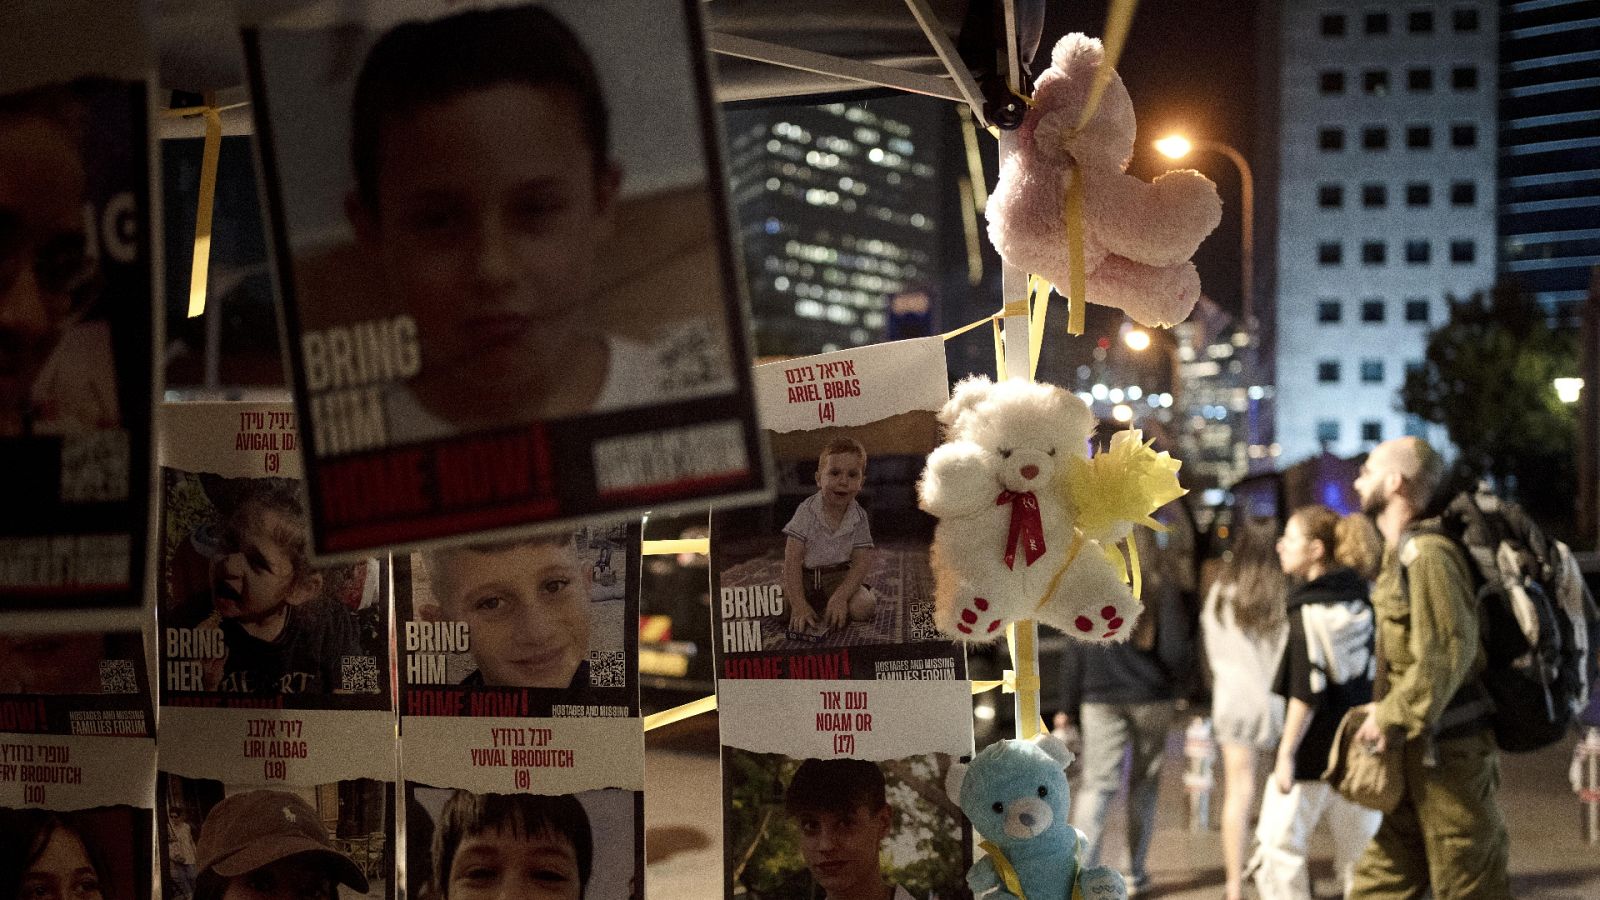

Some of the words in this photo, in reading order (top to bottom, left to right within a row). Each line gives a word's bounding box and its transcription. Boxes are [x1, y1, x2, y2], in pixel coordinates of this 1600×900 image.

[302, 315, 422, 390] BRING
[785, 366, 816, 384] ביבס
[816, 360, 857, 379] אריאל
[788, 383, 822, 403] ARIEL
[824, 379, 861, 399] BIBAS
[309, 385, 388, 457] HIM
[818, 402, 835, 423] (4)
[236, 433, 279, 450] AVIGAIL
[264, 453, 280, 474] (3)
[720, 584, 784, 620] BRING
[166, 627, 225, 659] BRING
[405, 621, 470, 653] BRING
[722, 620, 763, 654] HIM
[167, 660, 205, 692] HER
[407, 654, 447, 685] HIM
[725, 656, 784, 680] HOME
[407, 688, 465, 717] HOME
[470, 687, 528, 718] NOW!
[820, 691, 841, 710] אור
[845, 691, 867, 710] נעם
[0, 698, 48, 731] OW!
[816, 713, 852, 731] NOAM
[855, 713, 872, 731] OR
[71, 720, 112, 735] FAMILIES
[113, 719, 147, 735] FORUM
[247, 718, 276, 738] אלבג
[280, 719, 303, 738] לירי
[528, 727, 552, 746] יובל
[491, 728, 525, 748] ברודץ
[833, 733, 855, 755] (17)
[38, 745, 70, 763] עופרי
[243, 740, 265, 758] LIRI
[269, 740, 308, 759] ALBAG
[470, 748, 508, 767] YUVAL
[511, 749, 574, 768] BRODUTCH
[20, 764, 82, 785] BRODUTCH
[264, 760, 287, 781] (18)
[514, 769, 530, 790] (8)
[23, 784, 46, 805] (10)
